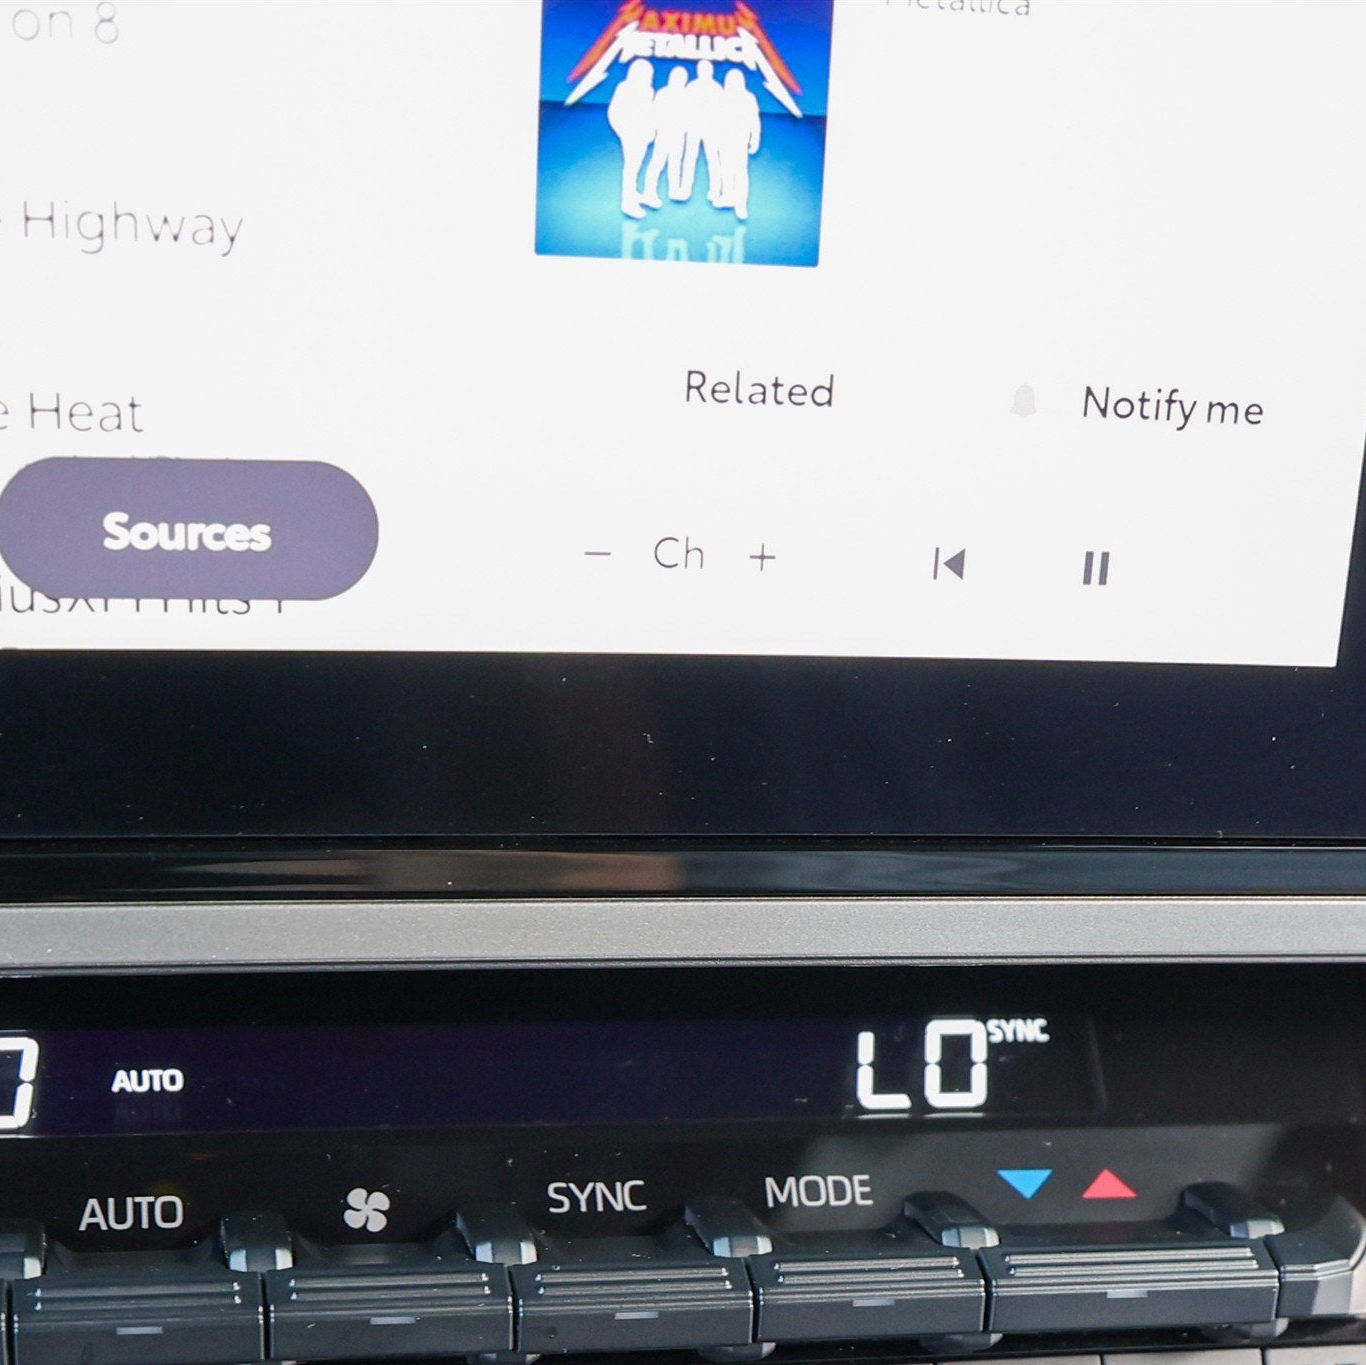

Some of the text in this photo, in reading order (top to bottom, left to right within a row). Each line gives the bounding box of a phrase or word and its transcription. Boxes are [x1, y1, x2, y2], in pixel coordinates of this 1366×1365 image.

[12, 9, 72, 41] on
[95, 2, 118, 44] 8
[24, 202, 242, 257] Highway
[686, 370, 834, 407] Related
[30, 393, 143, 432] Heat
[1083, 386, 1263, 431] Notify me
[103, 512, 271, 551] Sources
[654, 537, 703, 569] Ch
[987, 1019, 1049, 1042] SYNC
[112, 1069, 183, 1092] AUTO
[857, 1019, 987, 1109] LO
[548, 1180, 646, 1213] SYNC
[766, 1175, 873, 1207] MODE
[79, 1196, 183, 1230] AUTO
